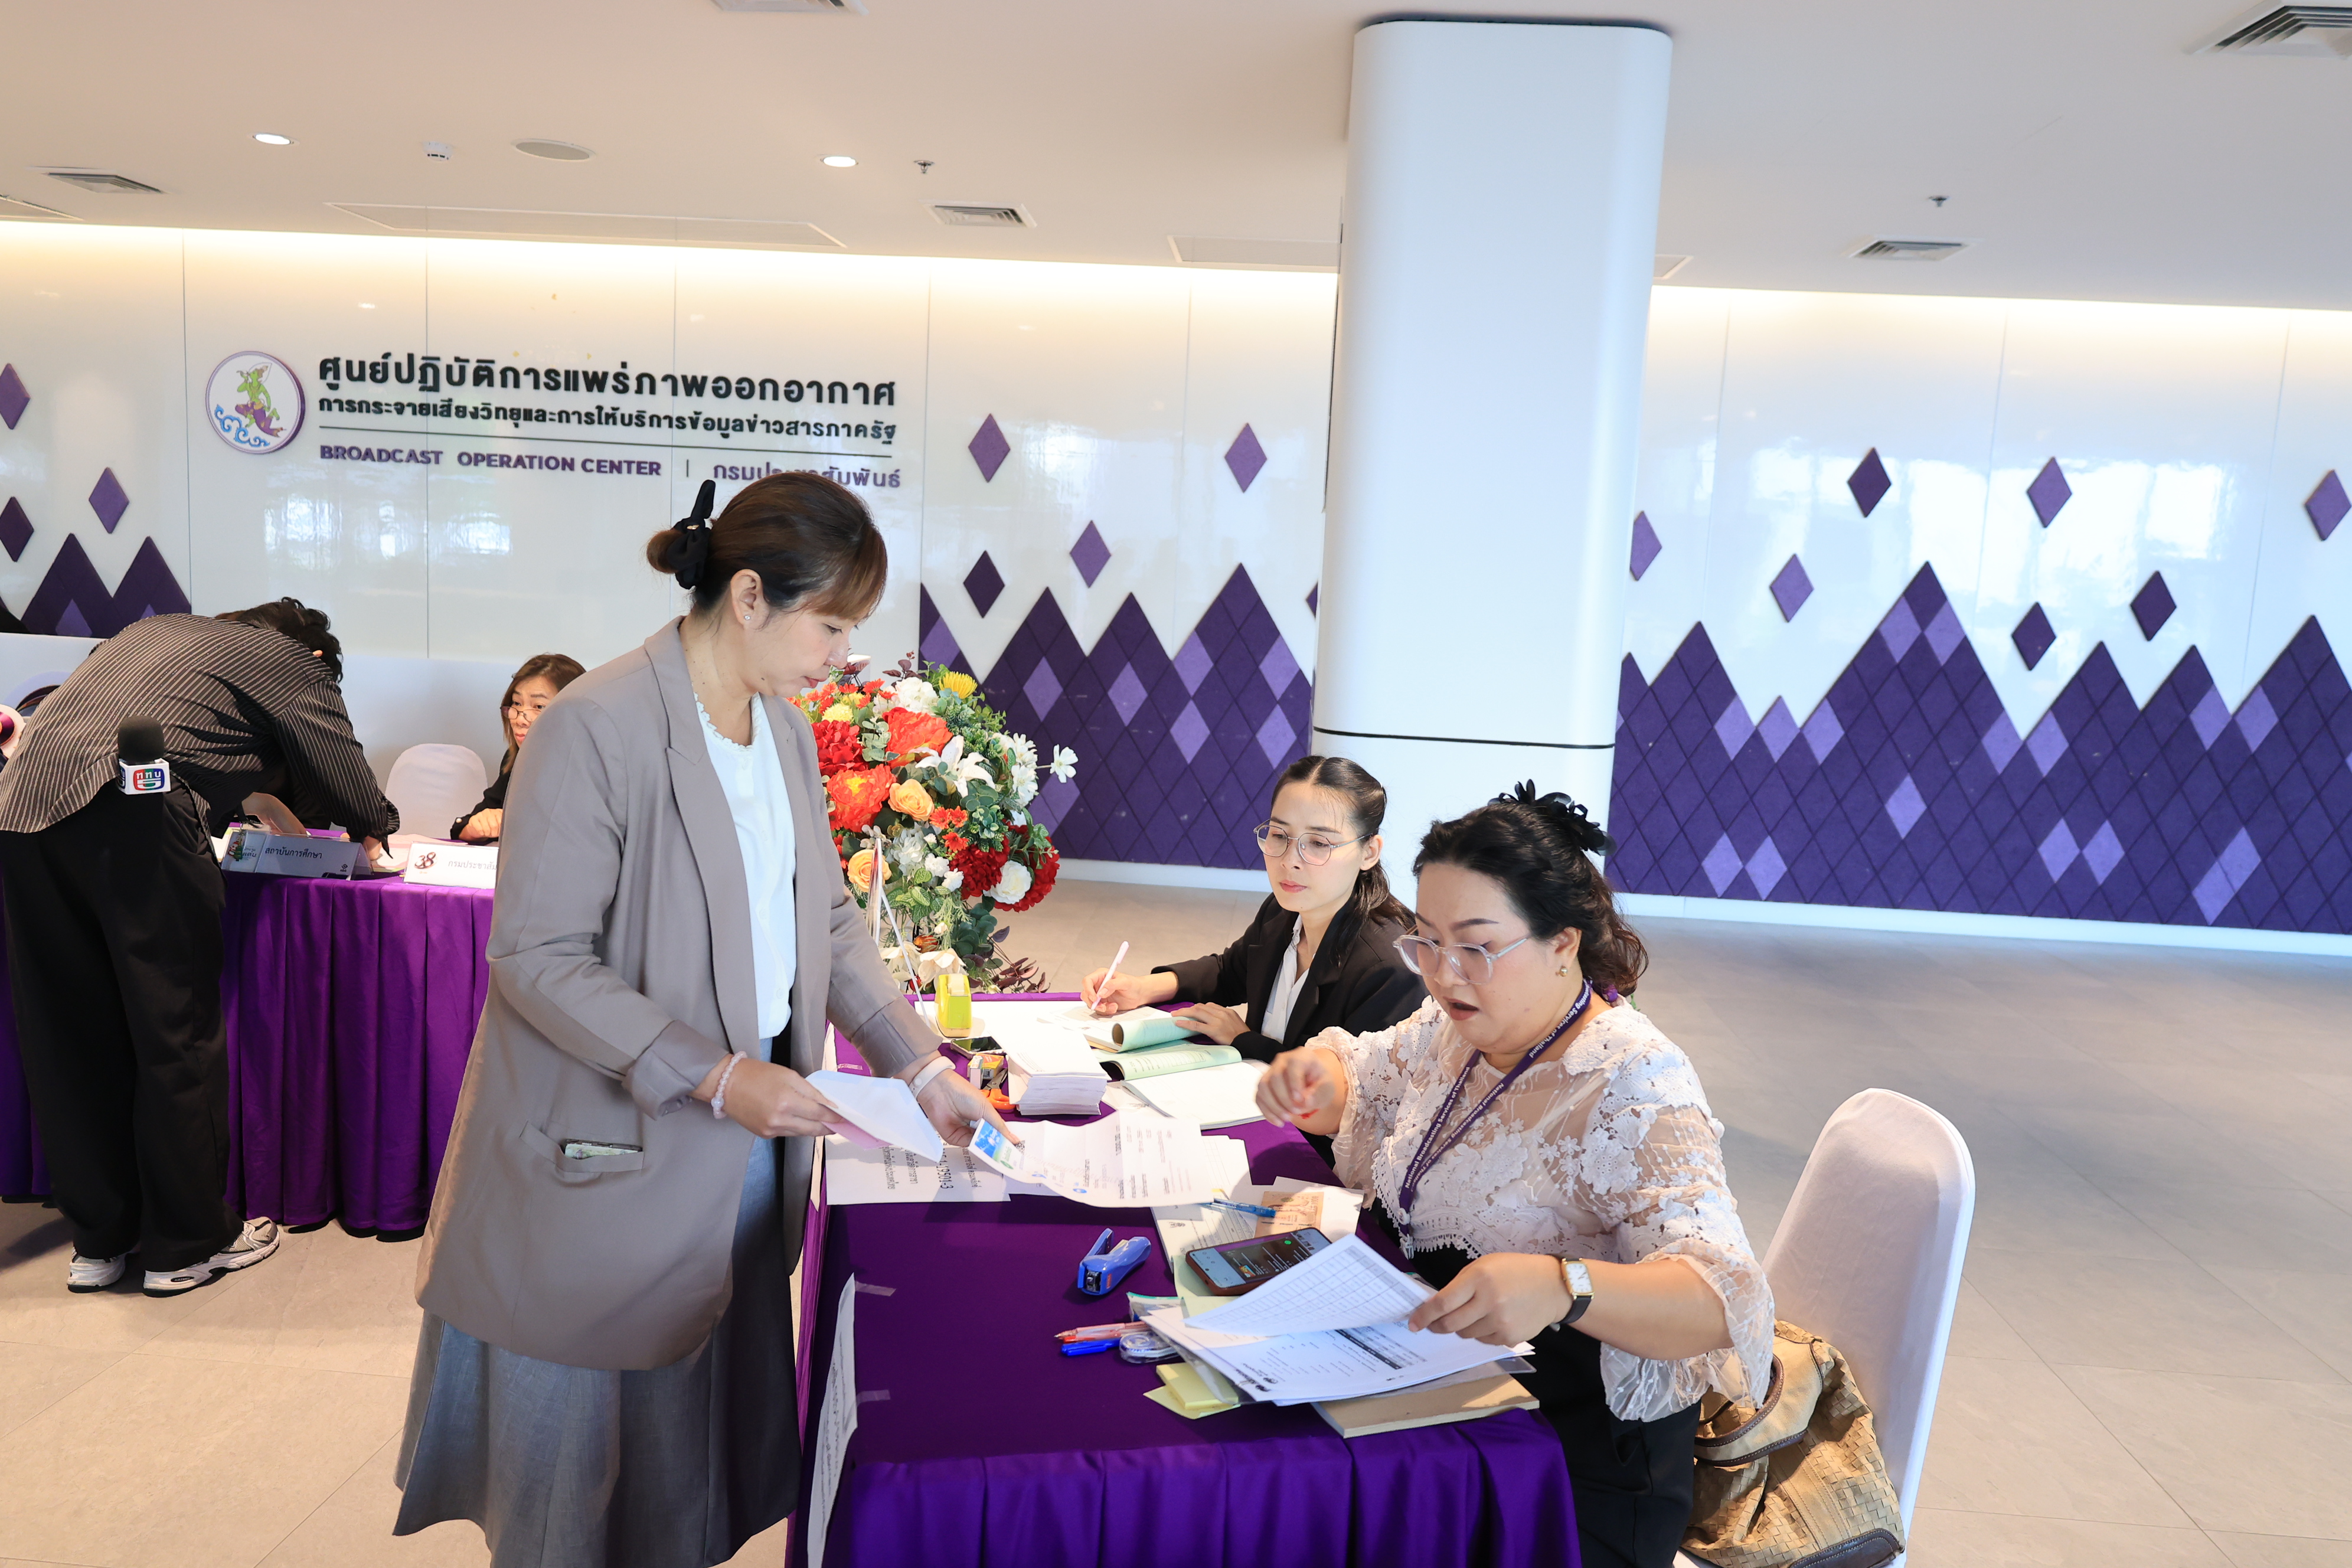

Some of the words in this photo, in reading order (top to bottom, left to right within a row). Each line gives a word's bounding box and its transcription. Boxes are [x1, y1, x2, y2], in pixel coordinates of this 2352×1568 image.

[319, 352, 895, 406] ศูนย์ปฏิบัติการแพร่ภาพออกอากาศ
[319, 397, 896, 445] การกระจายเสียงวิทยุและการให้บริการข้อมูลข่าวสารภาครัฐ
[320, 445, 443, 465] BROADCAST
[457, 451, 574, 472] OPERATION
[581, 458, 661, 476] CENTER
[265, 847, 322, 859] สถาบันการศึกษา
[1528, 1035, 1553, 1059] Thailand
[1482, 1083, 1504, 1106] National
[1405, 1161, 1420, 1188] National
[1416, 1123, 1442, 1161] Broadcasting
[1438, 1099, 1454, 1123] Services
[1454, 1067, 1470, 1091] Thailand
[1451, 1105, 1484, 1138] Broadcasting
[1432, 1138, 1452, 1159] Services
